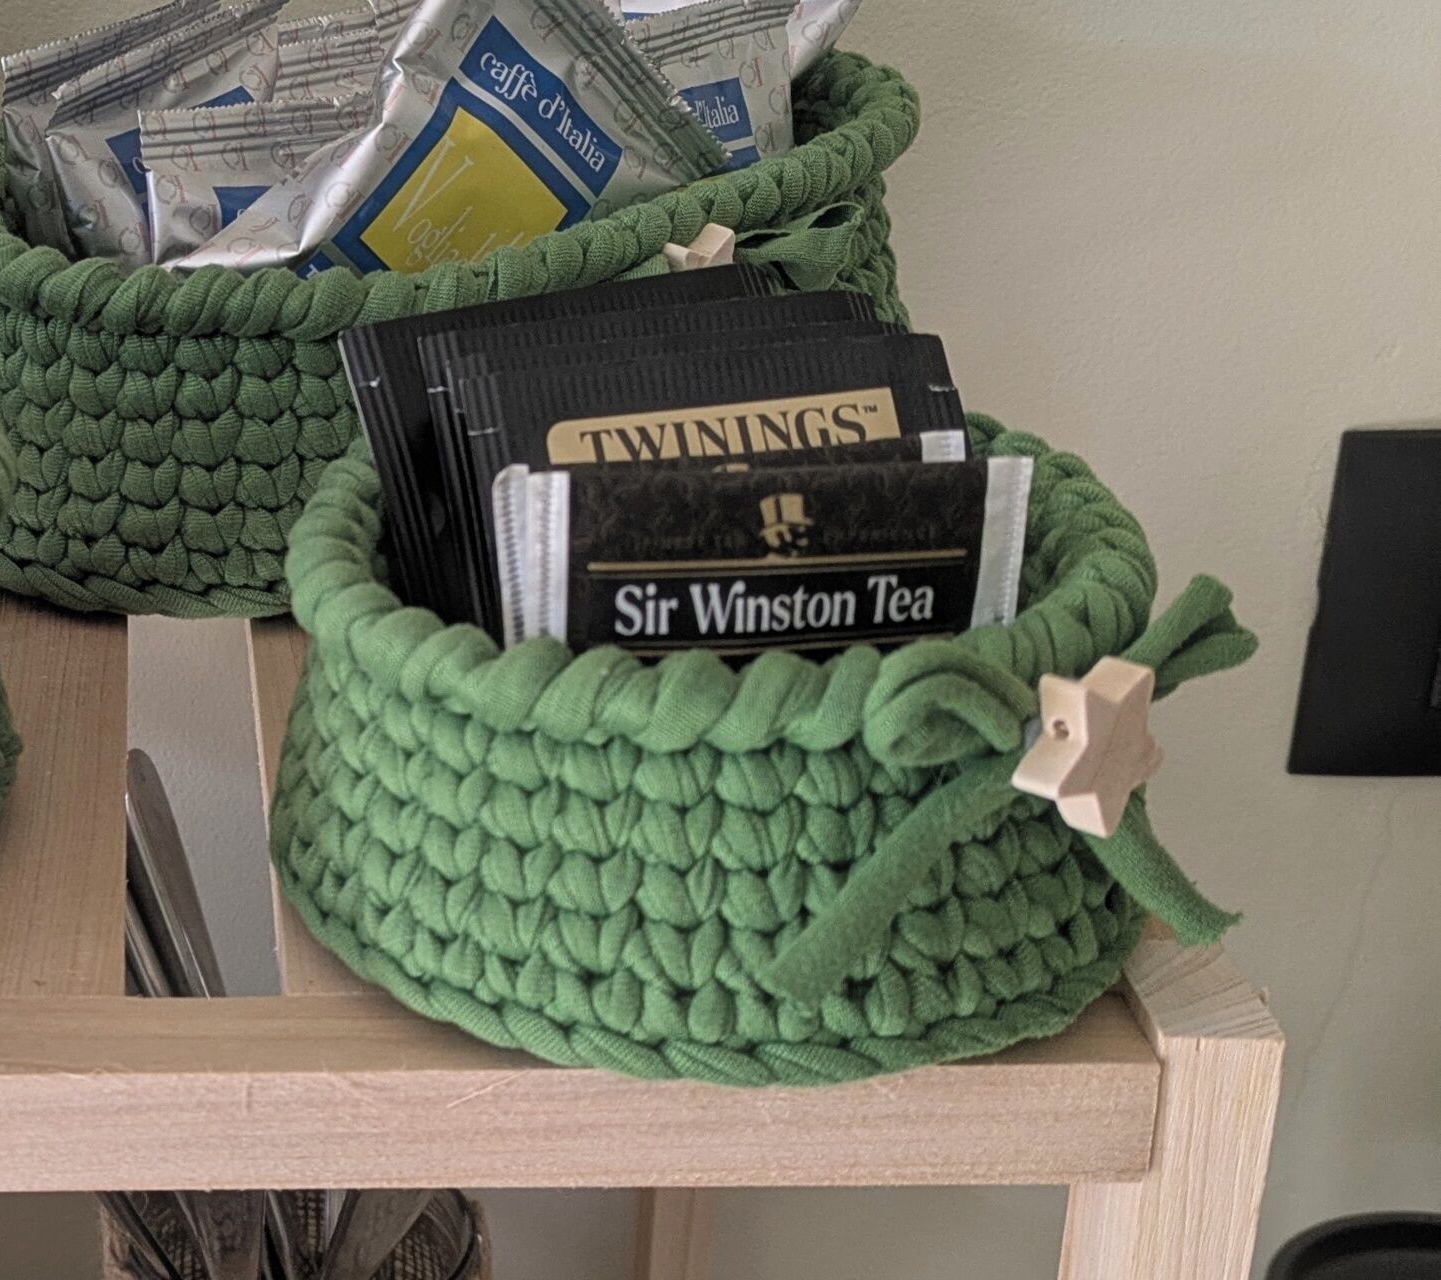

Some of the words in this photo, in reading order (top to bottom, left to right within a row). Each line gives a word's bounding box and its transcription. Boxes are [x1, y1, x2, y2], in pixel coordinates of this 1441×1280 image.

[479, 51, 538, 102] caffè
[537, 93, 606, 174] d'Italia
[691, 95, 740, 129] 'Italia
[614, 581, 679, 637] Sir
[689, 579, 856, 636] Winston
[867, 574, 936, 624] Tea
